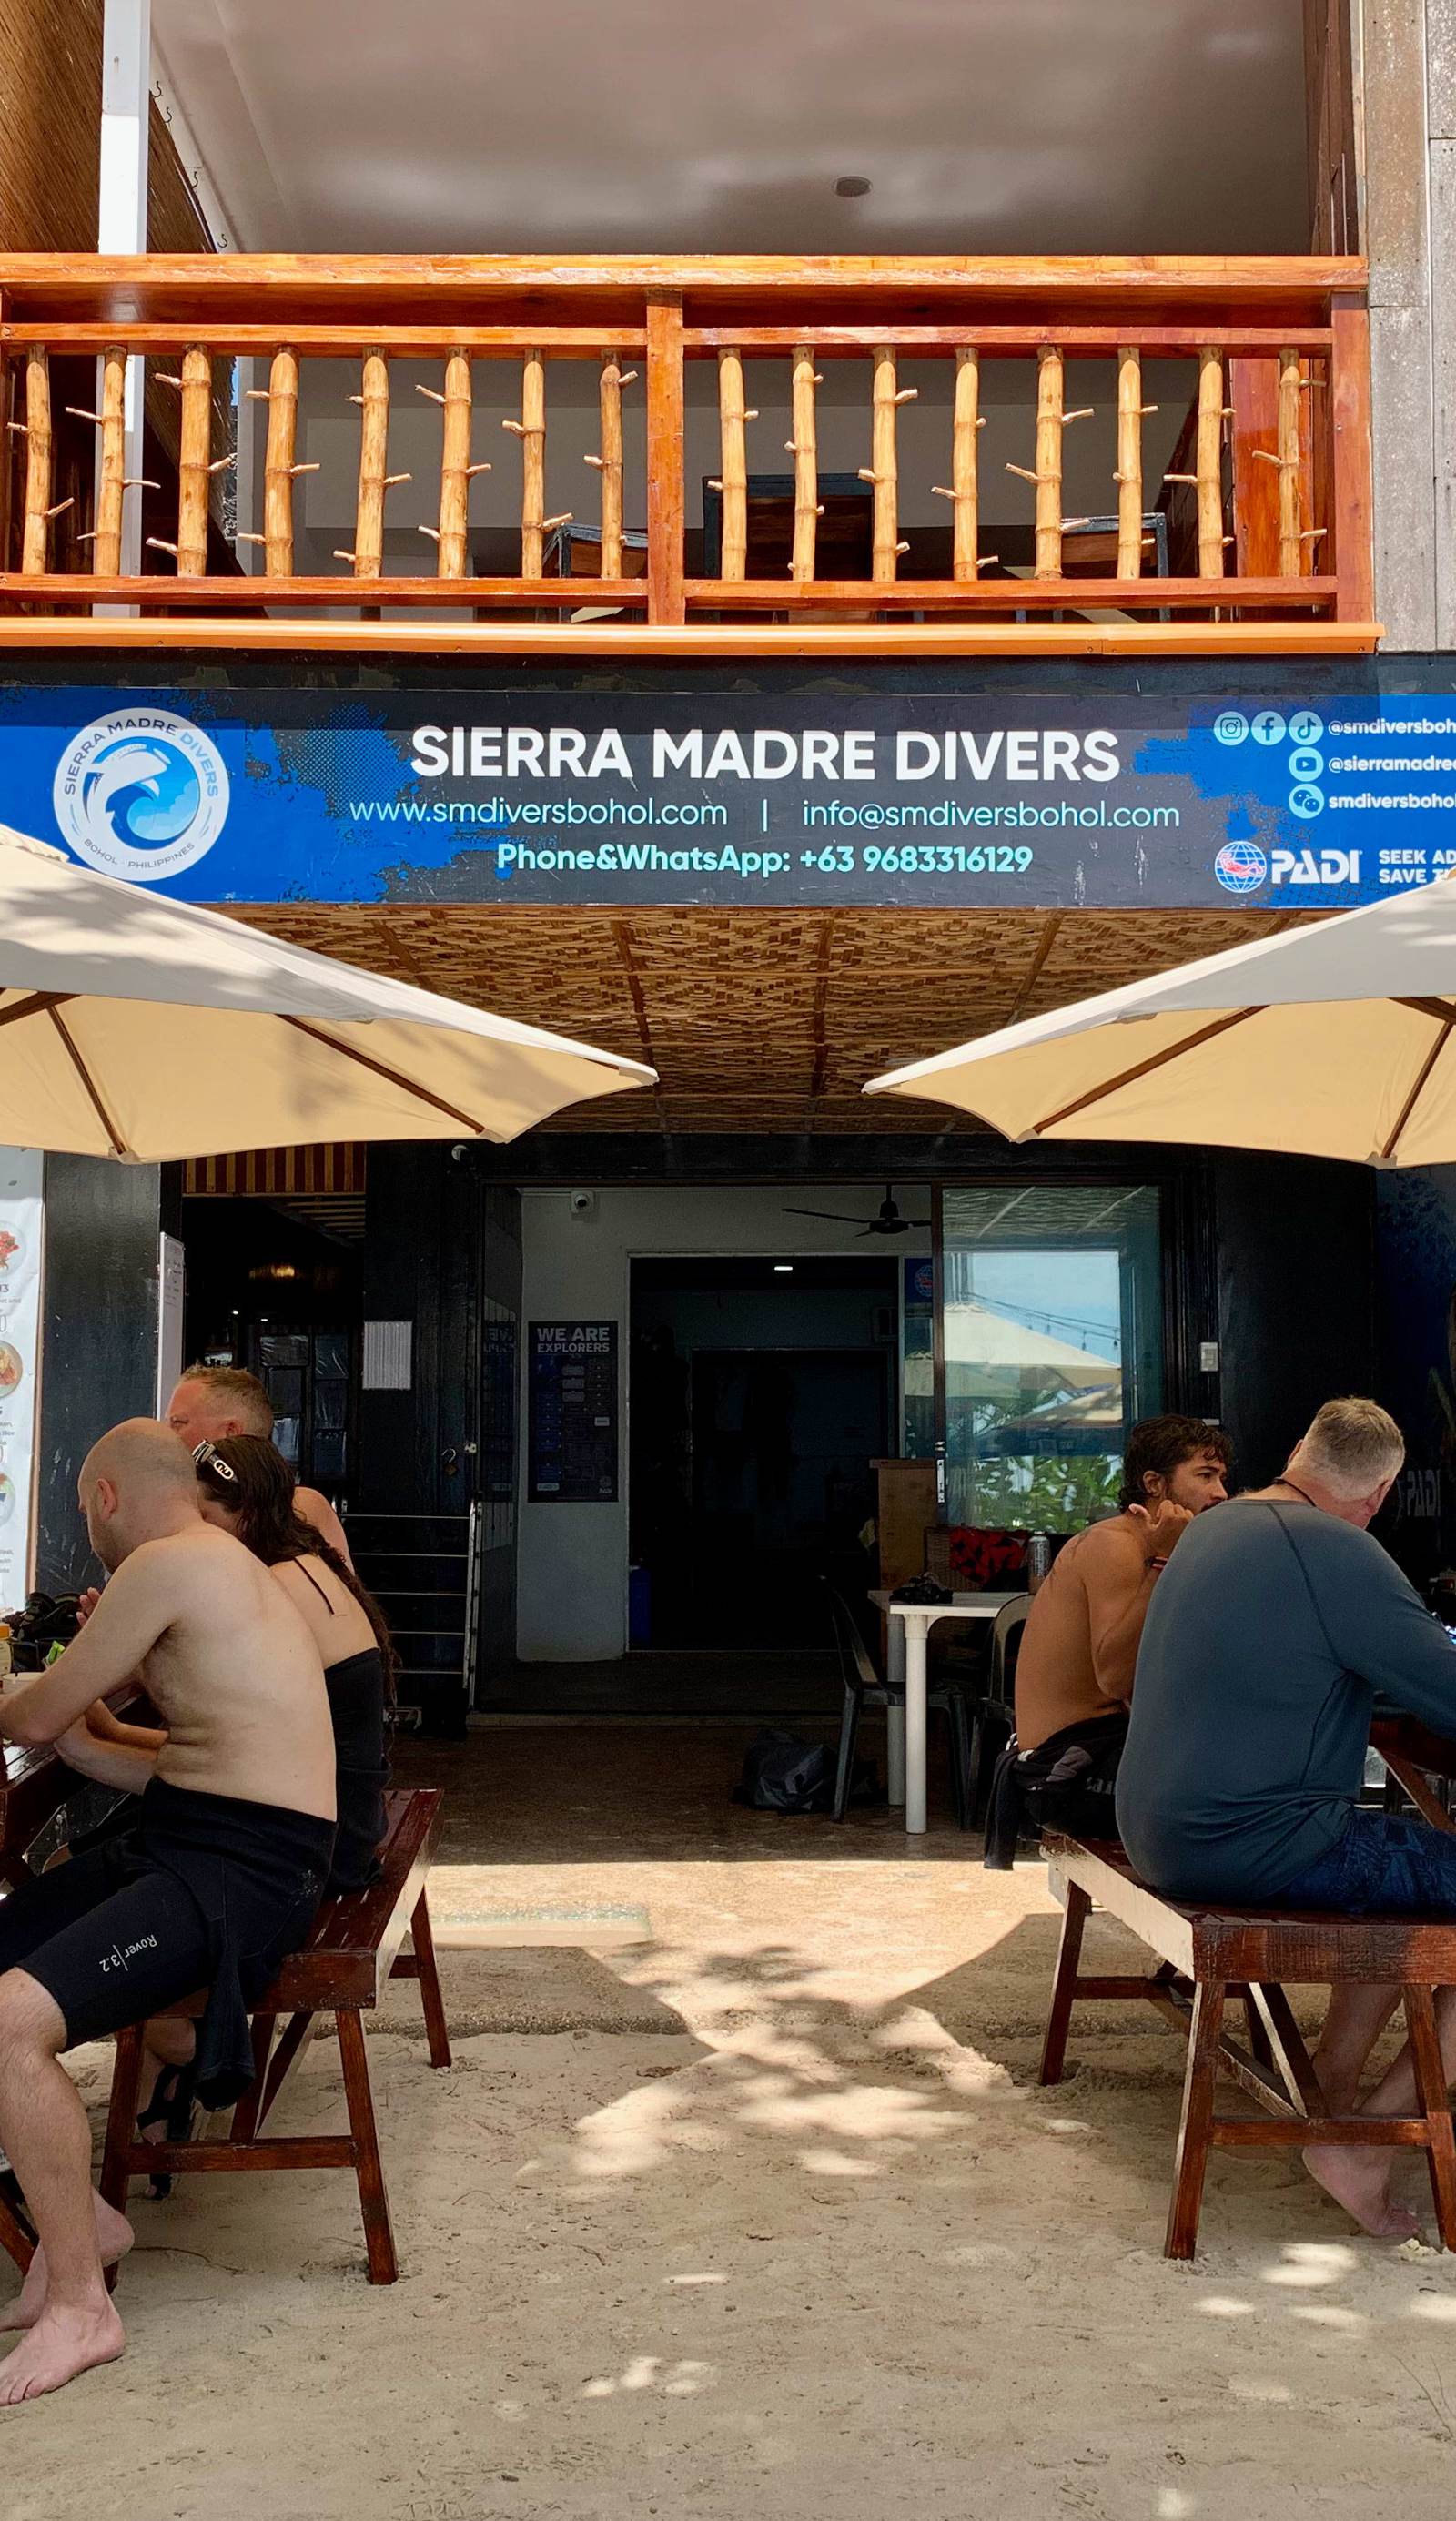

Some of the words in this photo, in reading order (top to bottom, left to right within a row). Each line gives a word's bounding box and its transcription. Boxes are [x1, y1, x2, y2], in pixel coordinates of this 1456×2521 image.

[1329, 718, 1456, 736] @smdiversboh
[65, 733, 106, 795] SIERRA
[107, 718, 178, 736] MADRE
[180, 732, 218, 797] DIVERS
[411, 725, 634, 778] SIERRA
[652, 728, 875, 780] MADRE
[895, 730, 1121, 782] DIVERS
[1329, 755, 1456, 774] @sierramadre
[349, 797, 727, 825] www.smdiversbohol.com
[803, 800, 1180, 830] info@smdiversbohol.com
[84, 838, 118, 866] BOHOL
[128, 842, 195, 869] PHILIPPINES
[498, 843, 791, 877] Phone&WhatsApp:
[800, 845, 854, 873] +63
[863, 845, 1033, 873] 9683316129
[1378, 849, 1427, 865] SEEK
[1431, 849, 1456, 865] AD
[1271, 849, 1360, 884] PADI
[1378, 867, 1427, 884] SAVE
[537, 1327, 566, 1341] WE
[571, 1327, 610, 1341] ARE
[537, 1342, 610, 1353] EXPLORERS
[125, 1934, 157, 1959] Rover
